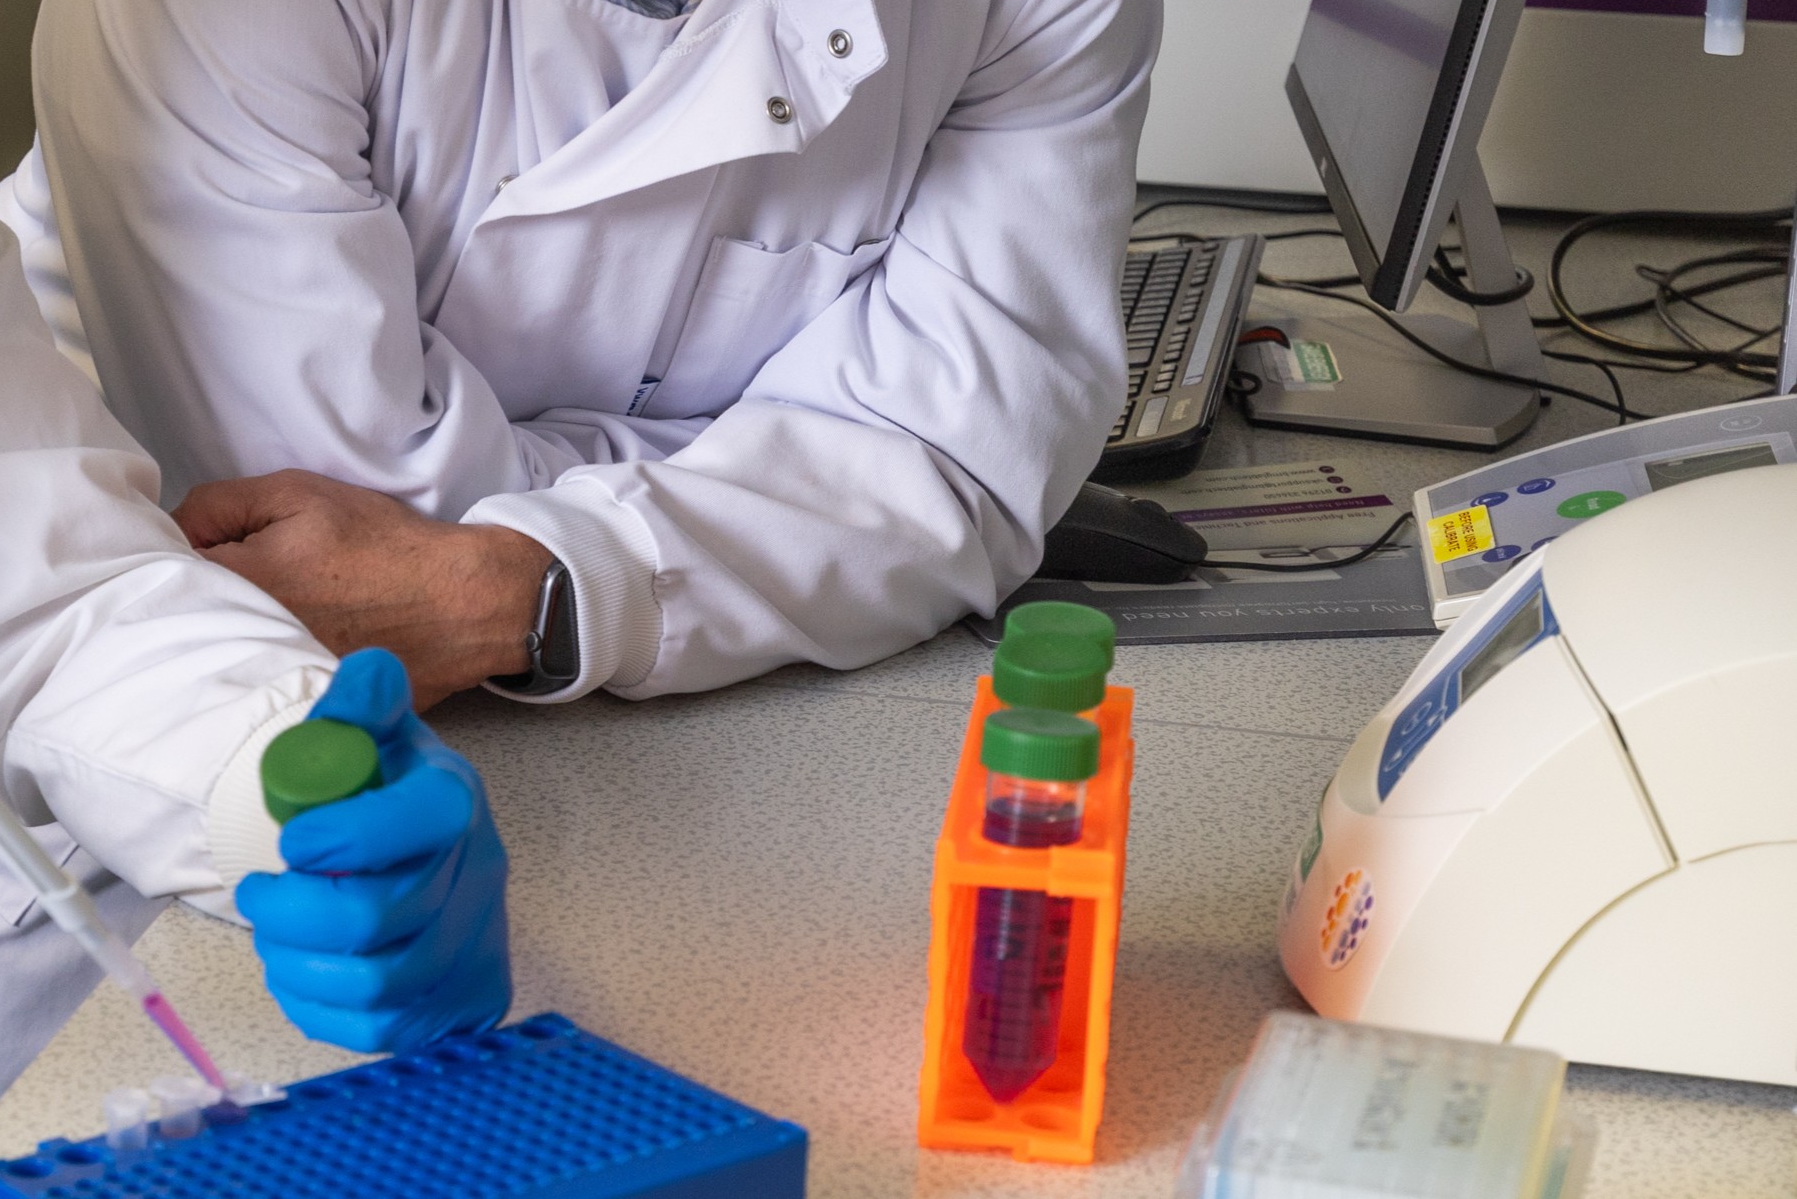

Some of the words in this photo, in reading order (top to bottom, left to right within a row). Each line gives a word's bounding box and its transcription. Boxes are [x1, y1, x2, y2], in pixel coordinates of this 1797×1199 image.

[1268, 513, 1344, 525] Applications
[1346, 511, 1376, 519] Free
[1459, 511, 1475, 534] BEFORE
[1443, 521, 1460, 552] CALIBRATE
[1464, 533, 1479, 552] USING
[1198, 608, 1248, 618] you
[1255, 605, 1360, 616] experts
[1371, 603, 1425, 614] only
[1121, 611, 1190, 622] need
